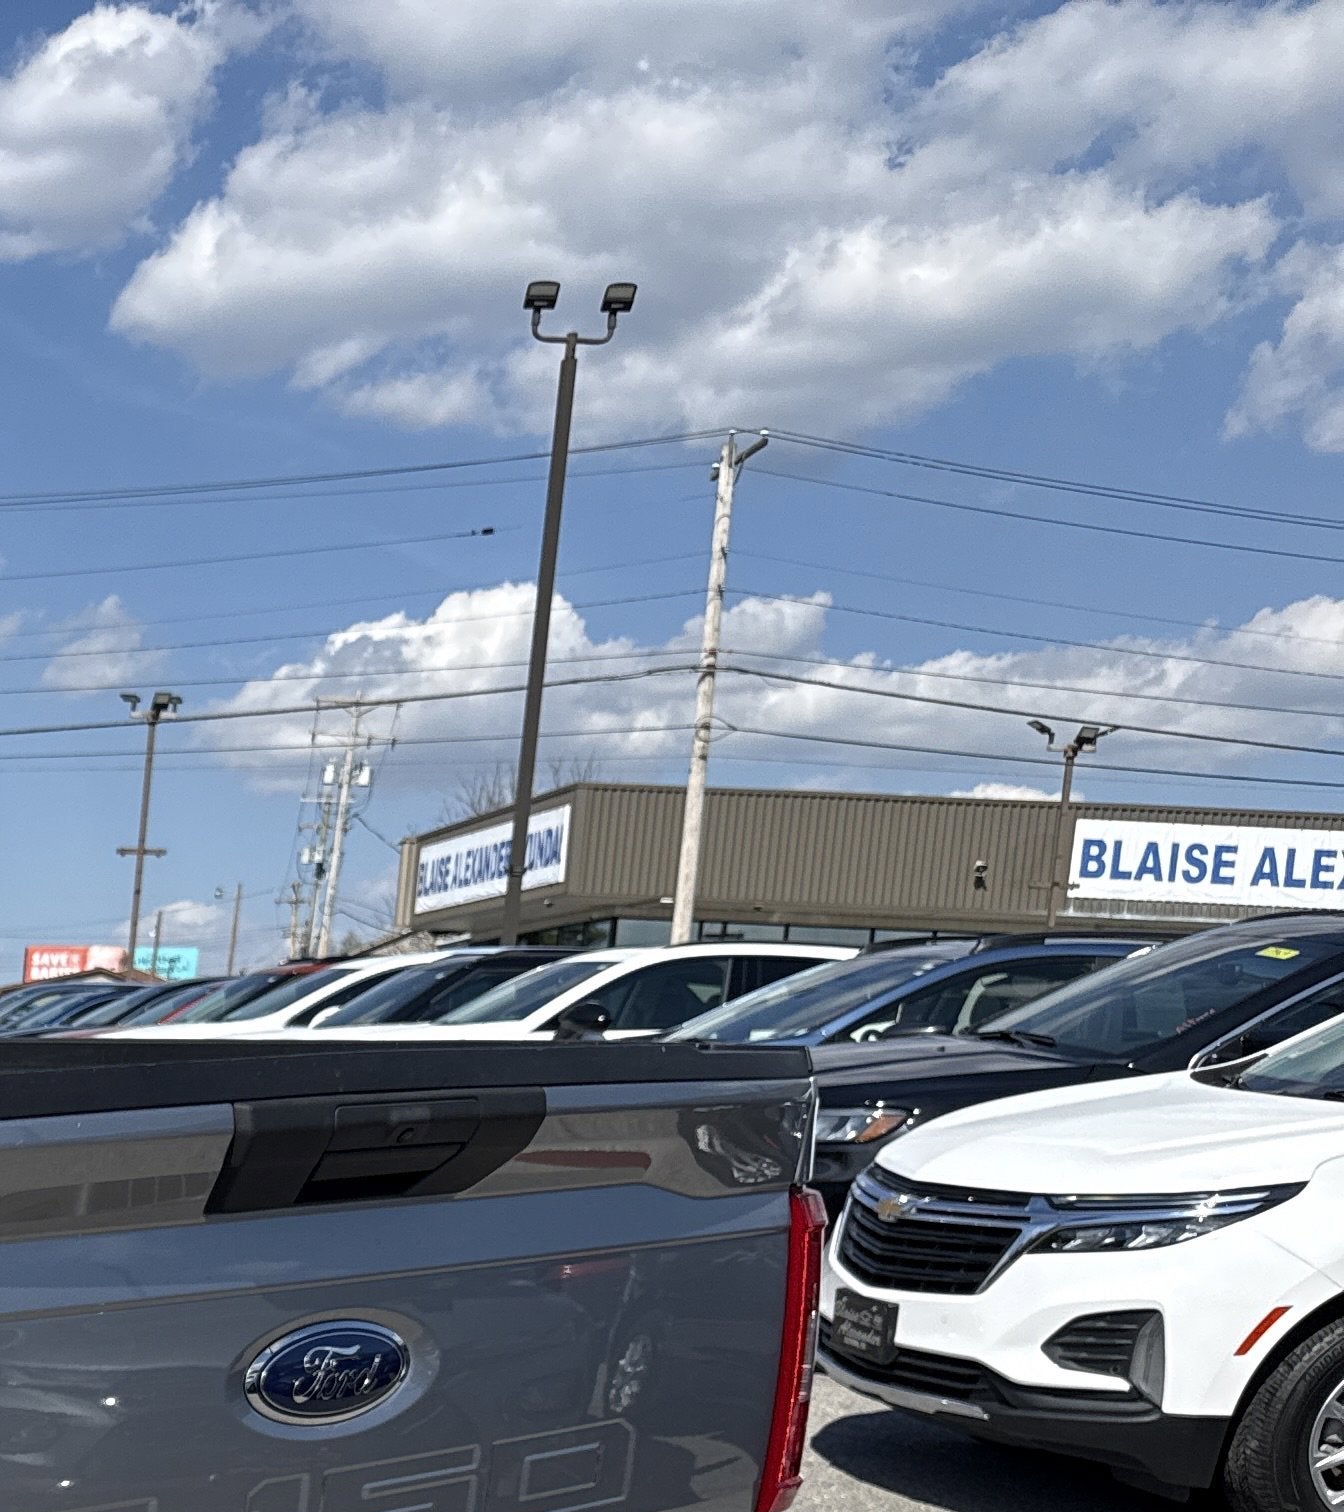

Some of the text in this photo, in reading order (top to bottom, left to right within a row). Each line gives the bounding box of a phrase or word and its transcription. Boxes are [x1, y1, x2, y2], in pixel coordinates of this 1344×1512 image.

[416, 855, 452, 897] BLAISE
[1078, 838, 1344, 890] BLAISE ALE
[293, 1344, 382, 1404] Ford
